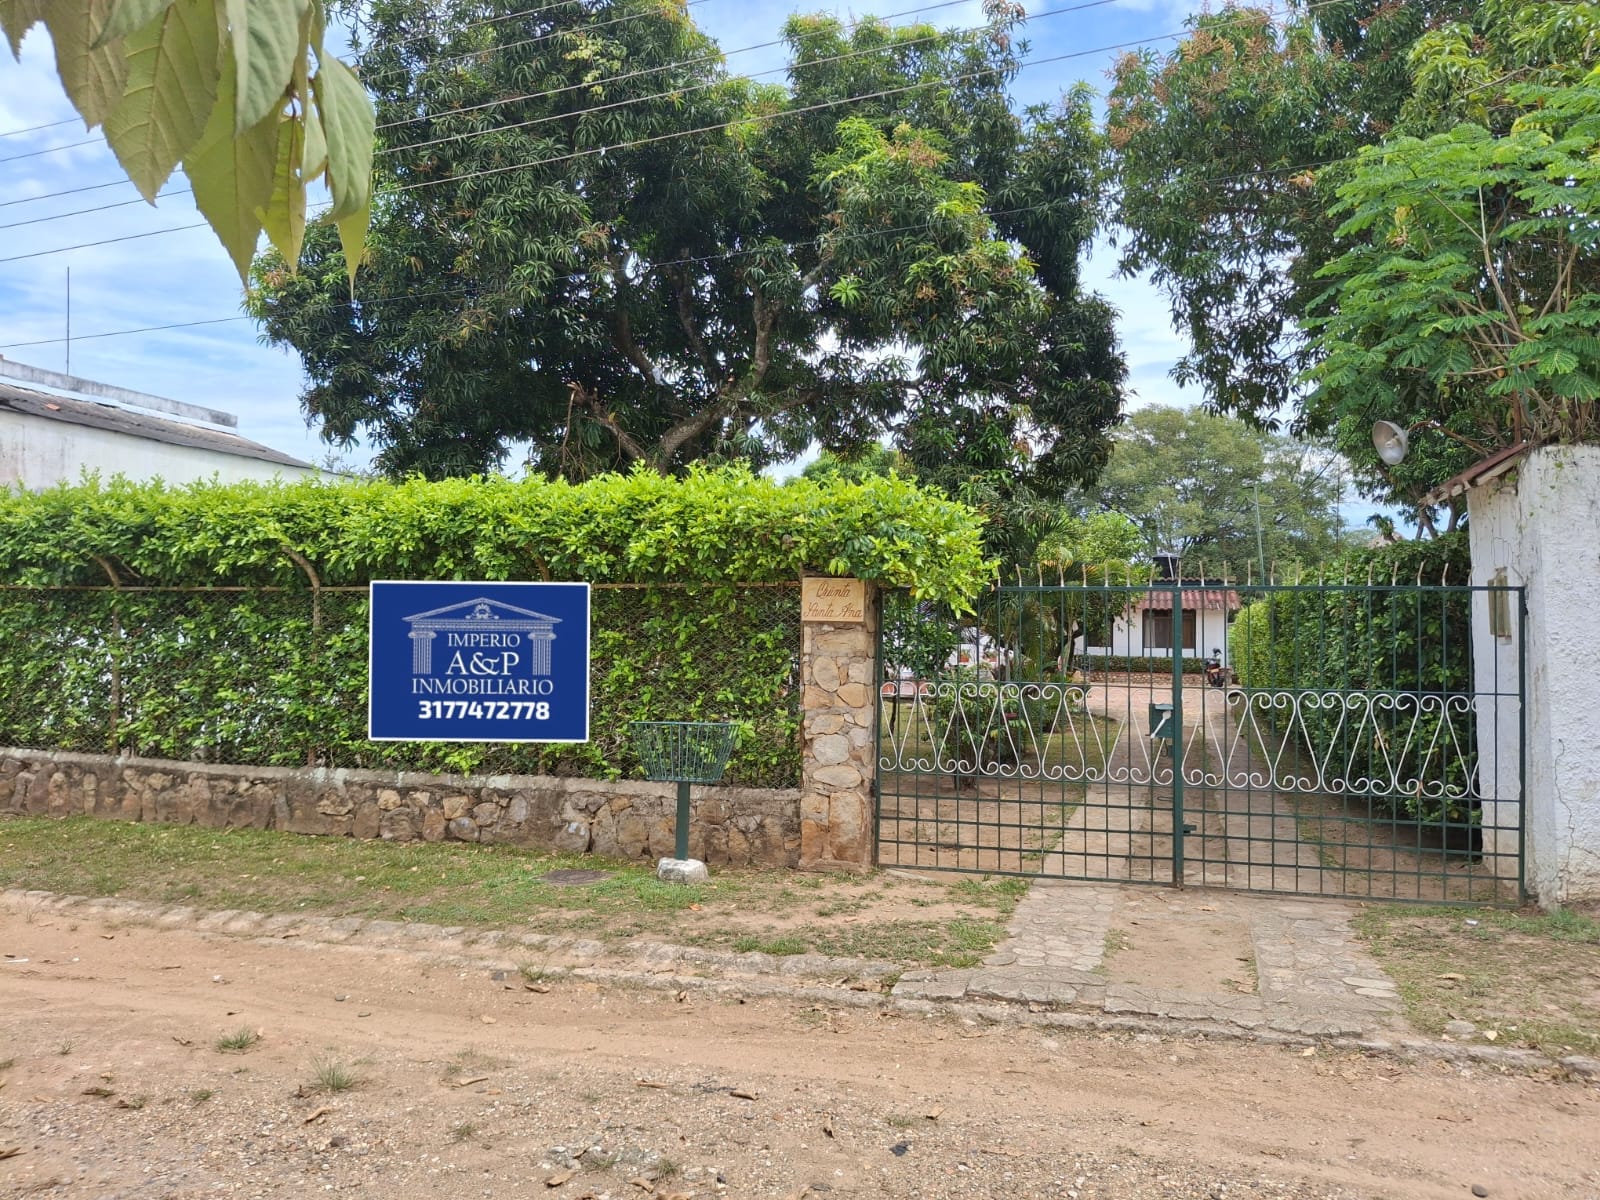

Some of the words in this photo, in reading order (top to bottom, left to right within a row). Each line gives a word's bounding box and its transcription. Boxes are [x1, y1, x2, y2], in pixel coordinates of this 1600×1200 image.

[816, 580, 851, 599] Quinta
[447, 633, 521, 648] IMPERIO
[445, 650, 520, 676] A&P
[411, 678, 554, 696] INMOBILIARIO
[418, 700, 551, 720] 3177472778
